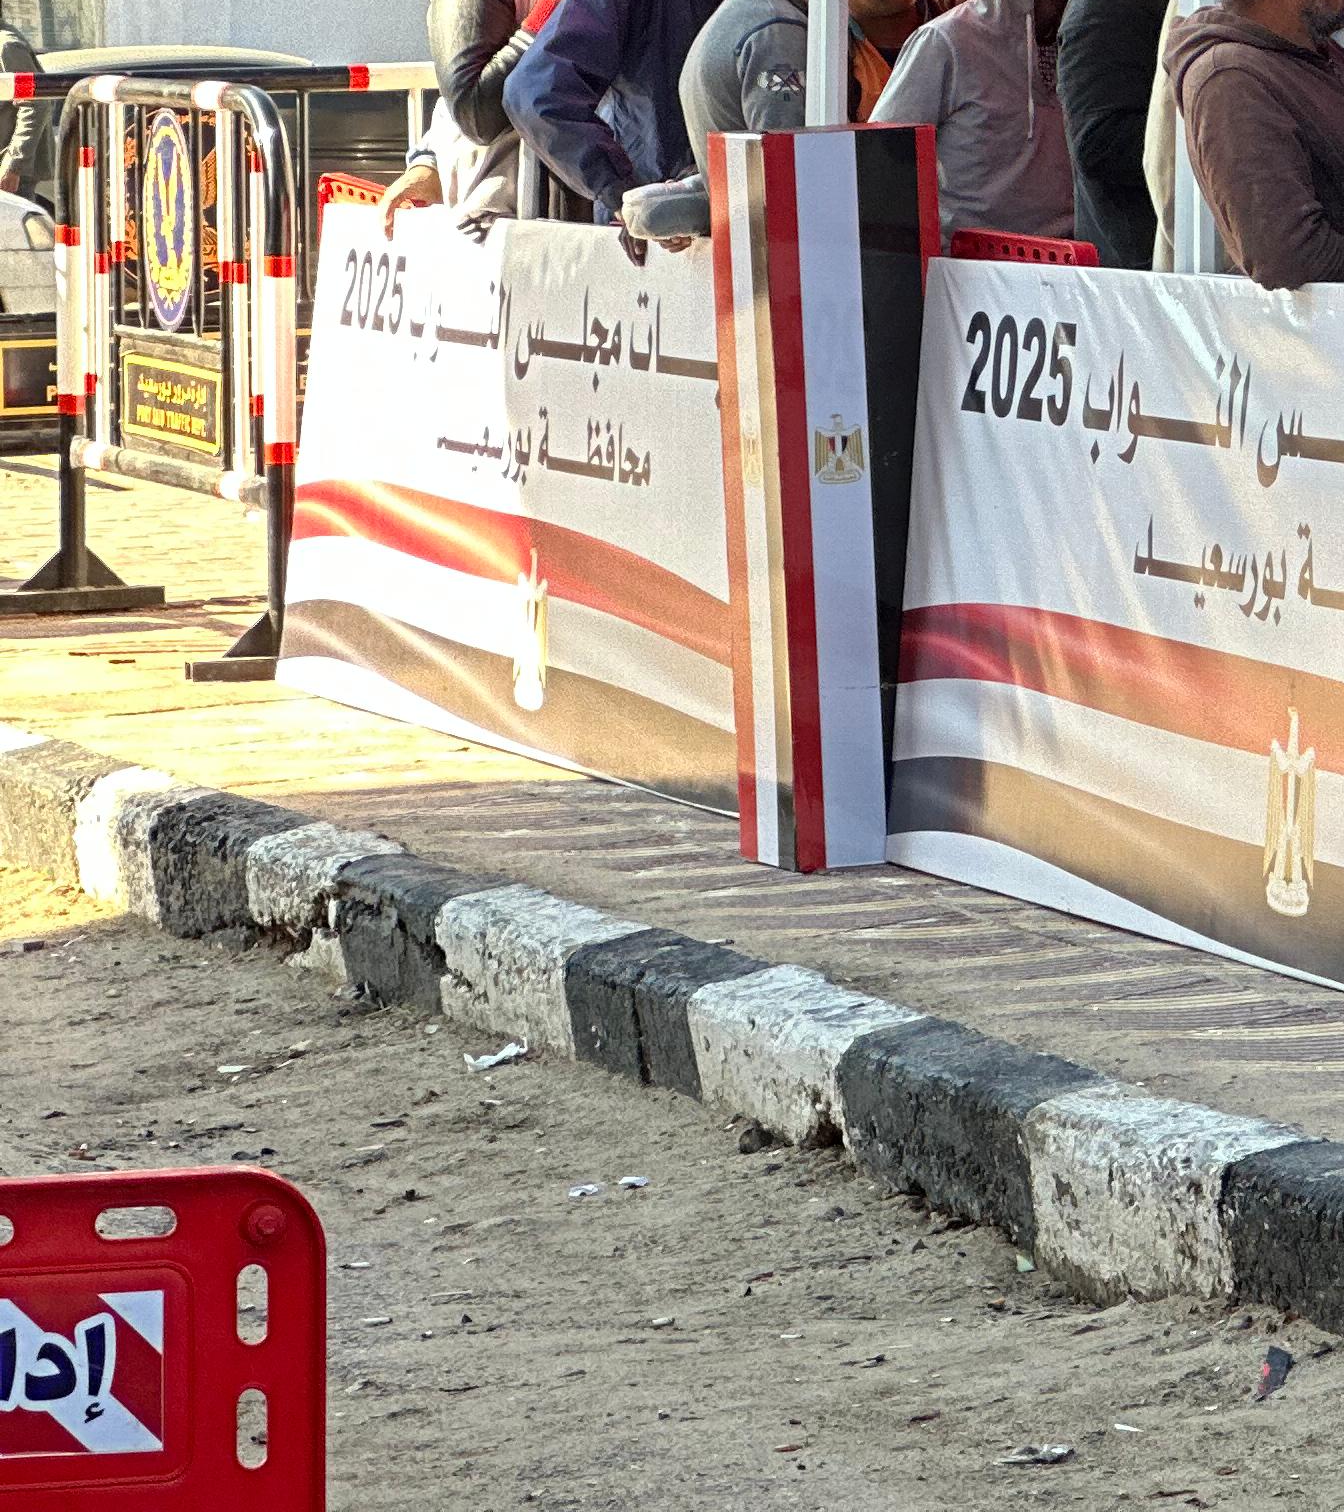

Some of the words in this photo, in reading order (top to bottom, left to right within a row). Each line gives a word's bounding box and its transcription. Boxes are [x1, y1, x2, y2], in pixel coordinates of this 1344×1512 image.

[340, 248, 407, 335] 2025
[514, 285, 622, 394] مجلس
[960, 310, 1077, 428] 2025
[1082, 349, 1252, 465] النواب
[538, 406, 652, 487] محافظة
[1134, 513, 1287, 627] بورسعيد
